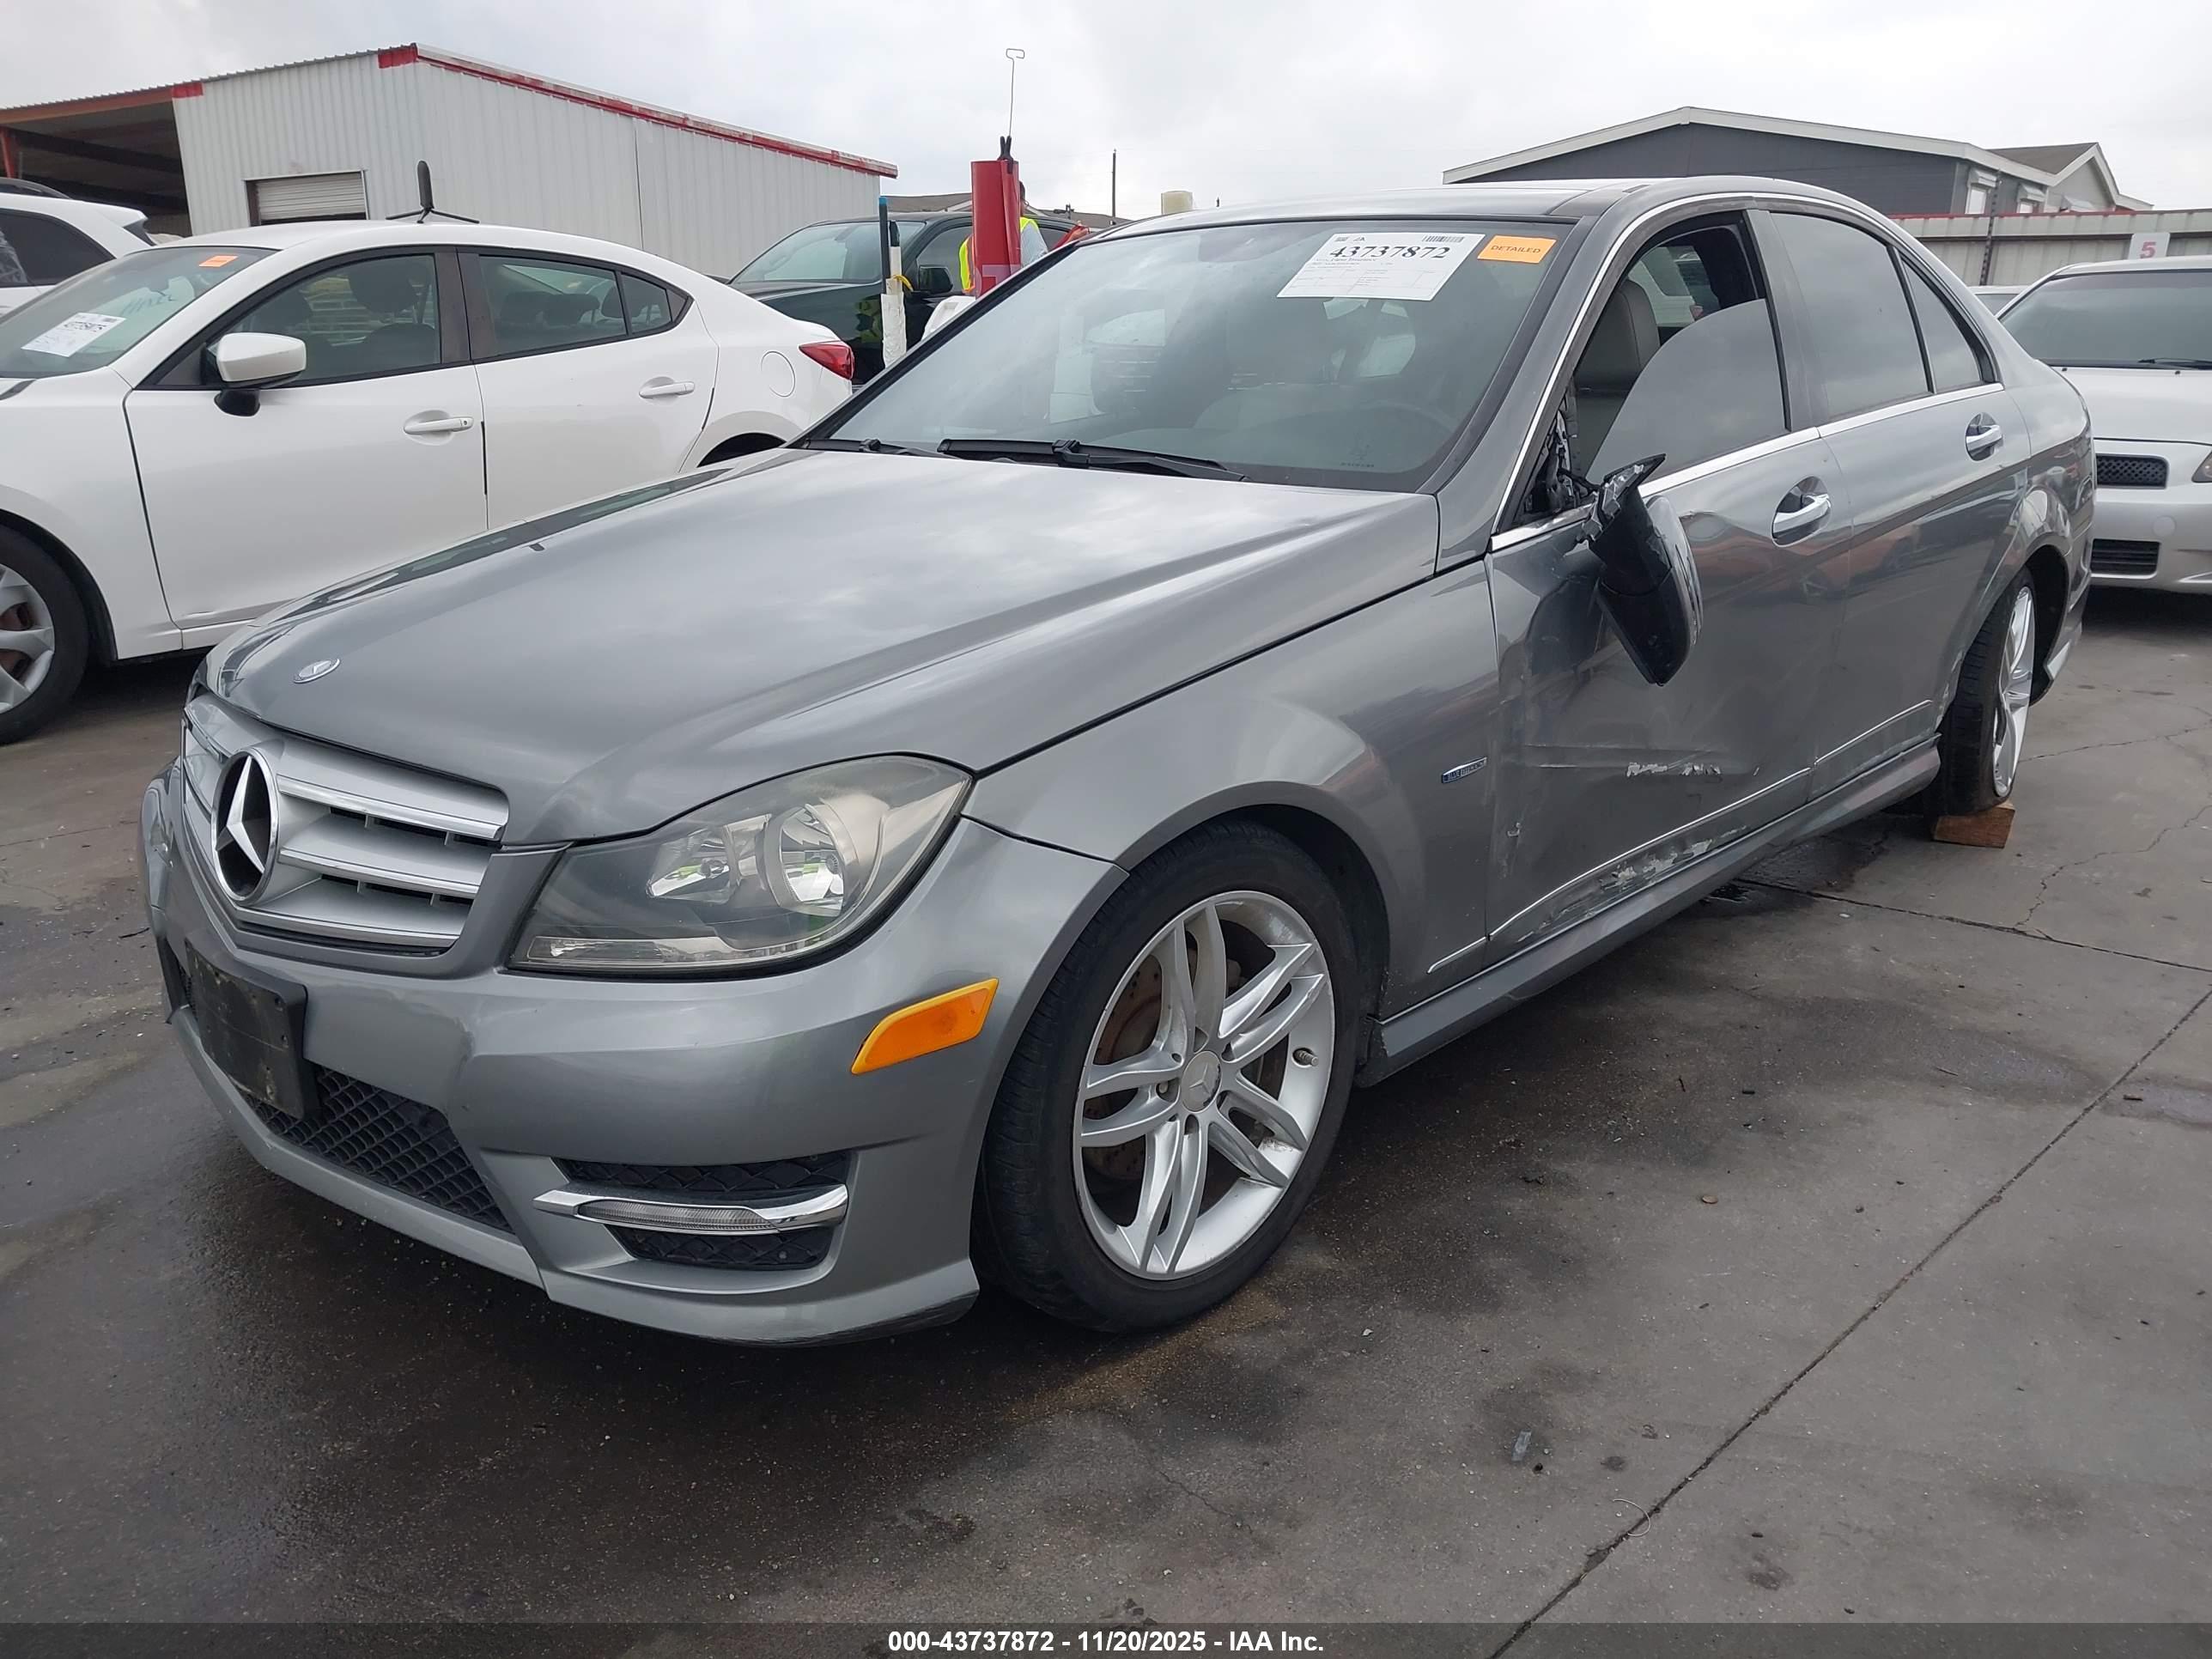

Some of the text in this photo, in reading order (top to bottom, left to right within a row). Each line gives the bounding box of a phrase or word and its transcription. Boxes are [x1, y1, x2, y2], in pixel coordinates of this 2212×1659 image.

[1330, 246, 1450, 258] 43737872
[1491, 245, 1541, 253] DETAILED
[2139, 241, 2157, 258] 5
